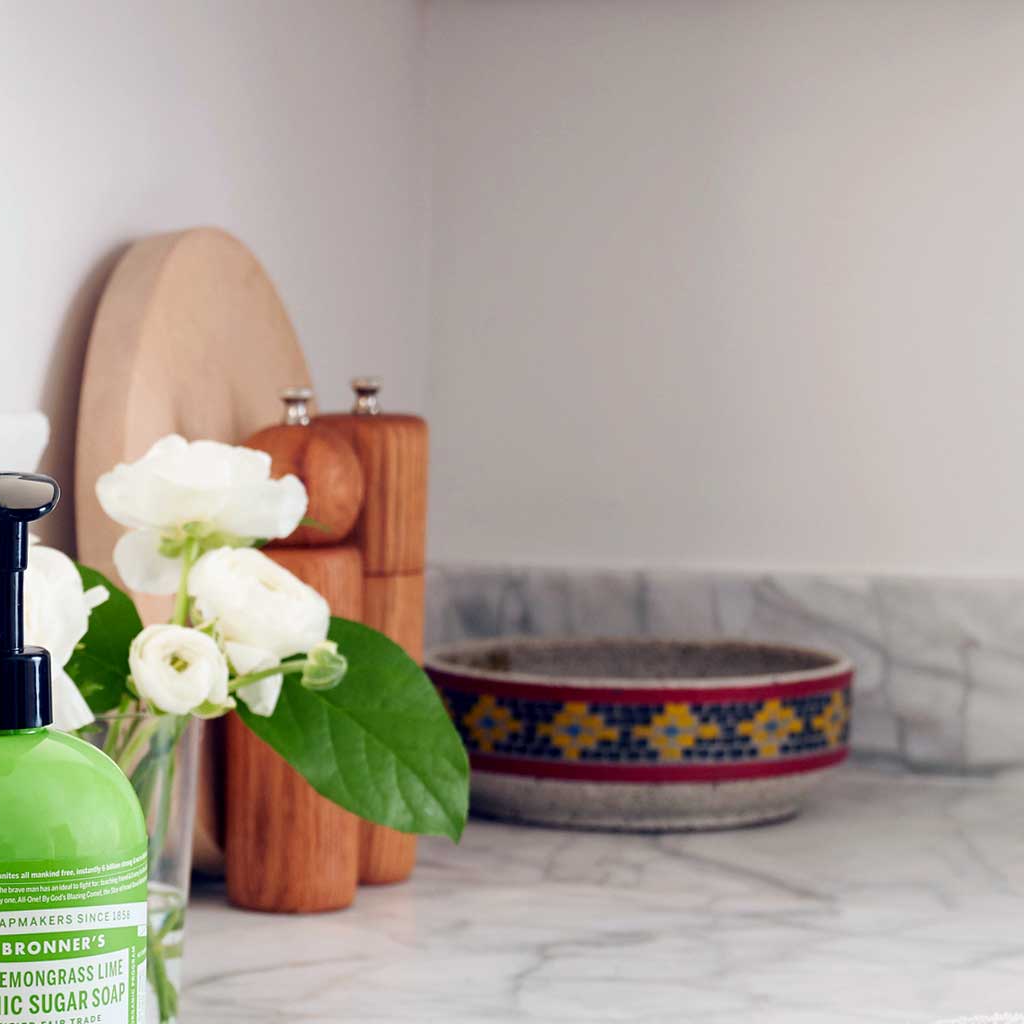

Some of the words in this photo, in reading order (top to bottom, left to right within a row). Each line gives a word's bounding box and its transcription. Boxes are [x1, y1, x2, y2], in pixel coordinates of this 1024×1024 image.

[31, 870, 60, 879] mankind
[77, 912, 108, 924] SINCE
[2, 934, 105, 955] BRONNER'S
[98, 960, 123, 979] LIME
[29, 990, 88, 1014] SUGAR
[92, 982, 125, 1007] SOAP
